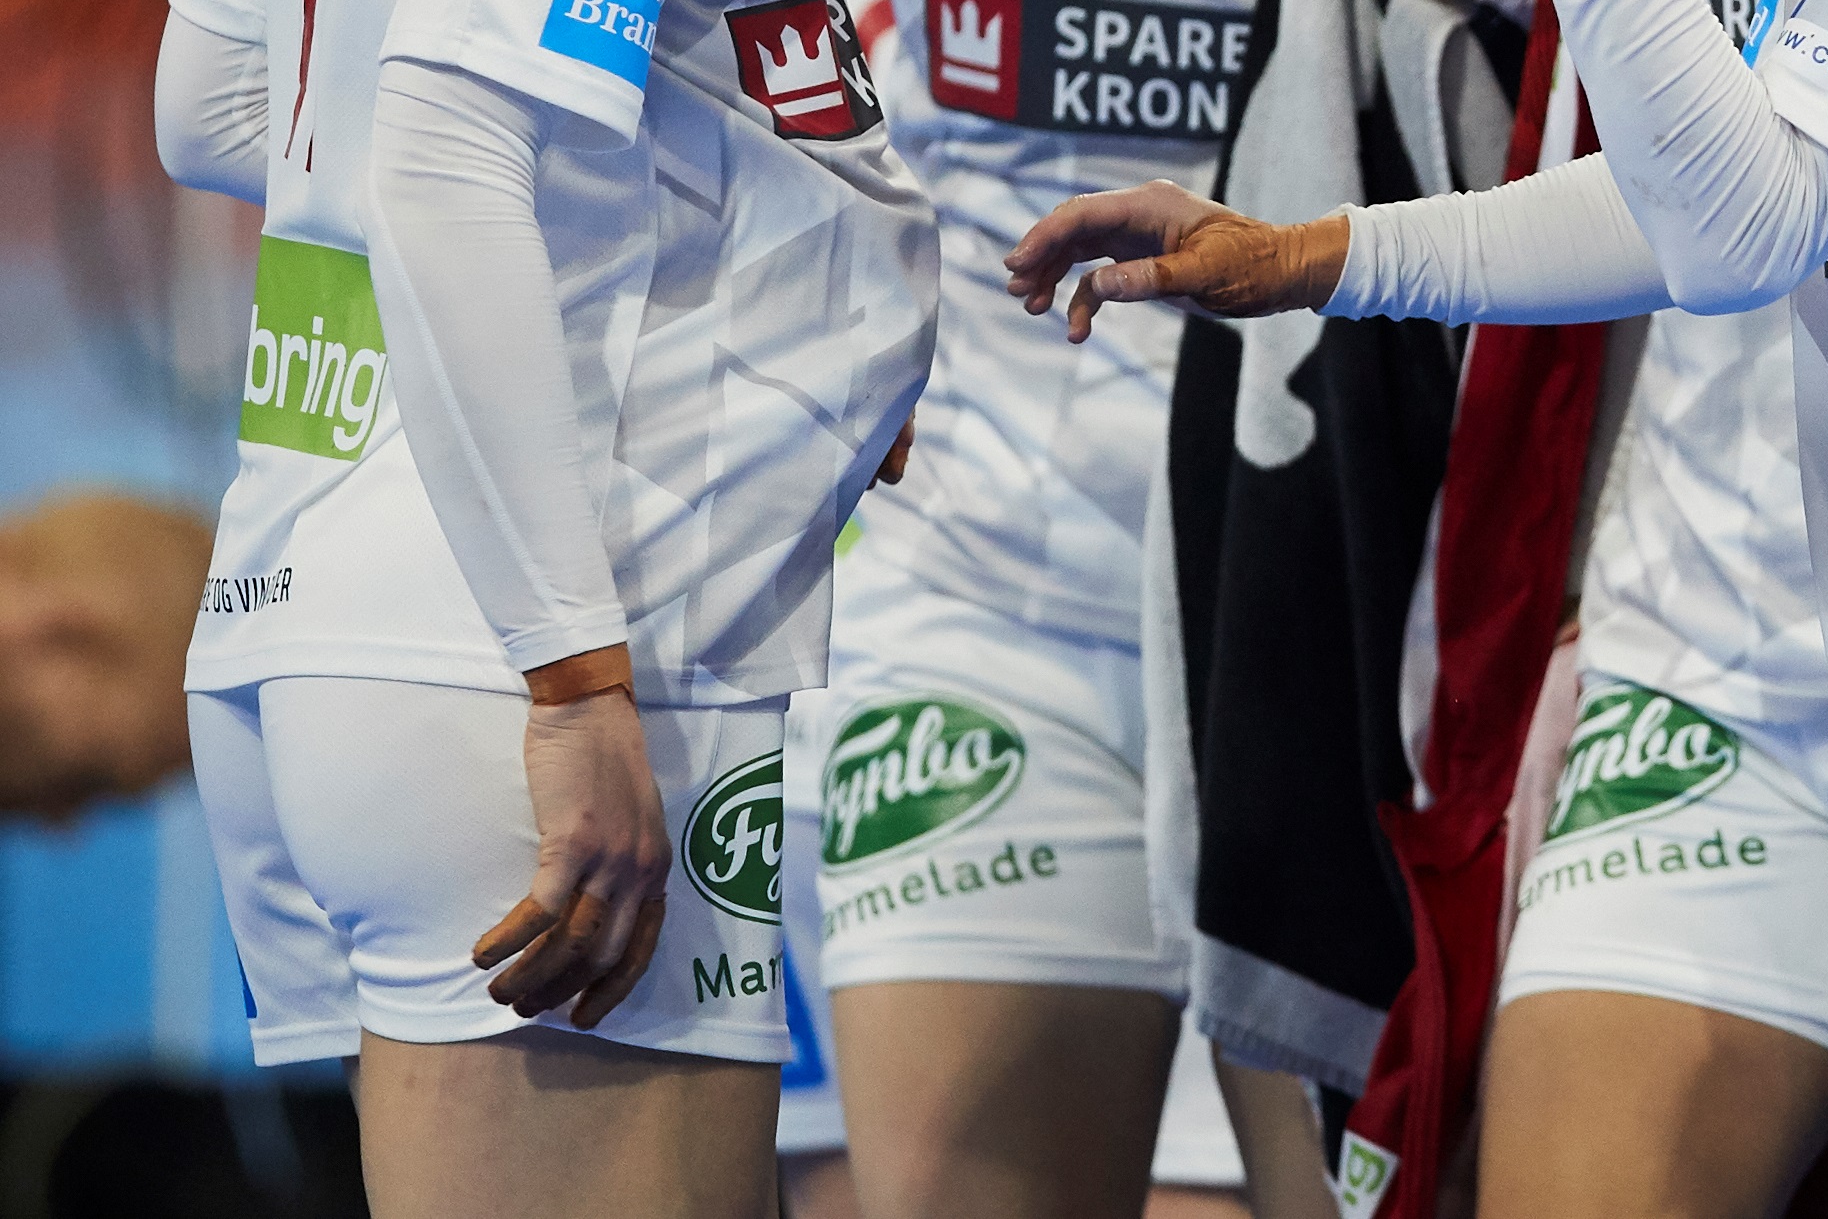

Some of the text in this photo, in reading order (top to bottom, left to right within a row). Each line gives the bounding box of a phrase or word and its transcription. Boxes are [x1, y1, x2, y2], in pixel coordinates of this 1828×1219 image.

[1053, 5, 1252, 74] SPARE
[1051, 67, 1230, 133] KRON
[242, 304, 387, 452] bring
[213, 577, 234, 613] OG
[234, 566, 293, 613] VINER
[692, 950, 783, 1003] Mar
